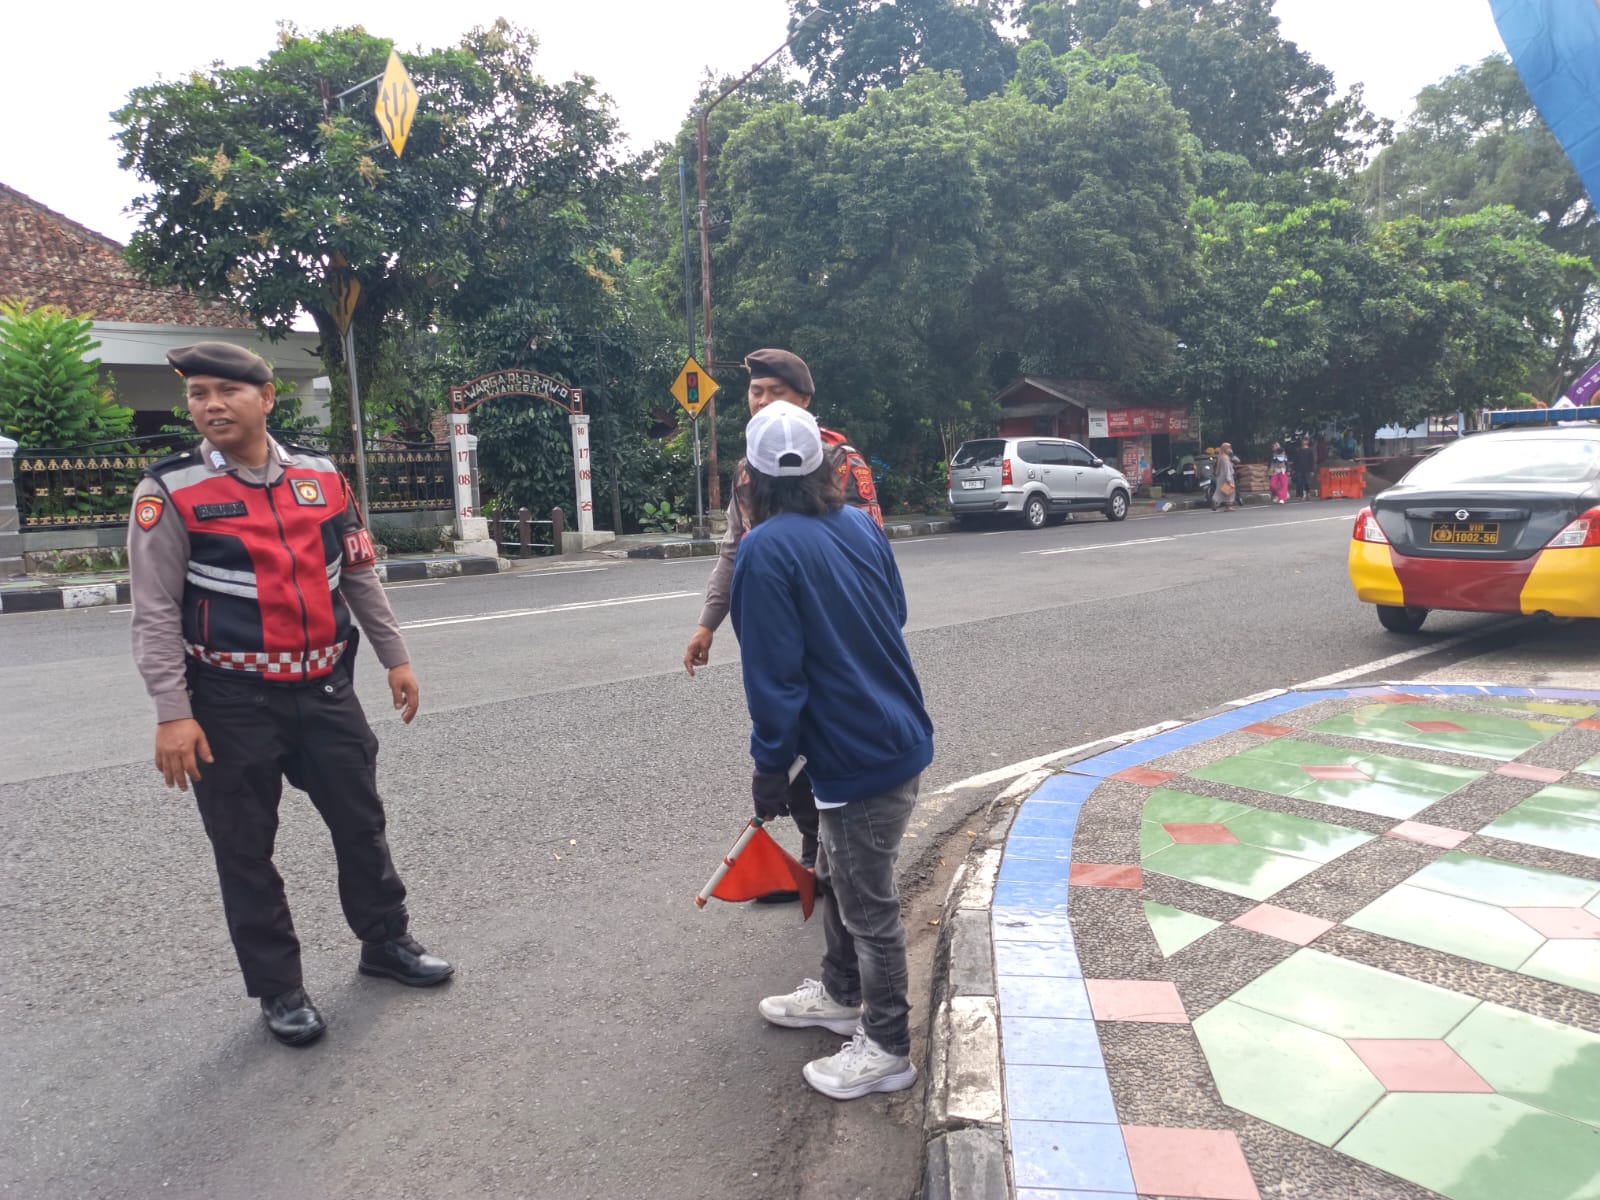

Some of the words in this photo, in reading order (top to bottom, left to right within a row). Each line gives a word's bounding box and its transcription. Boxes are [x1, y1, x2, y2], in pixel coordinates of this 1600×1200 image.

[458, 451, 469, 462] 17
[579, 448, 589, 459] 17
[458, 474, 471, 485] 08
[579, 470, 591, 480] 08
[460, 507, 473, 517] 45
[1455, 533, 1496, 543] 1002-56
